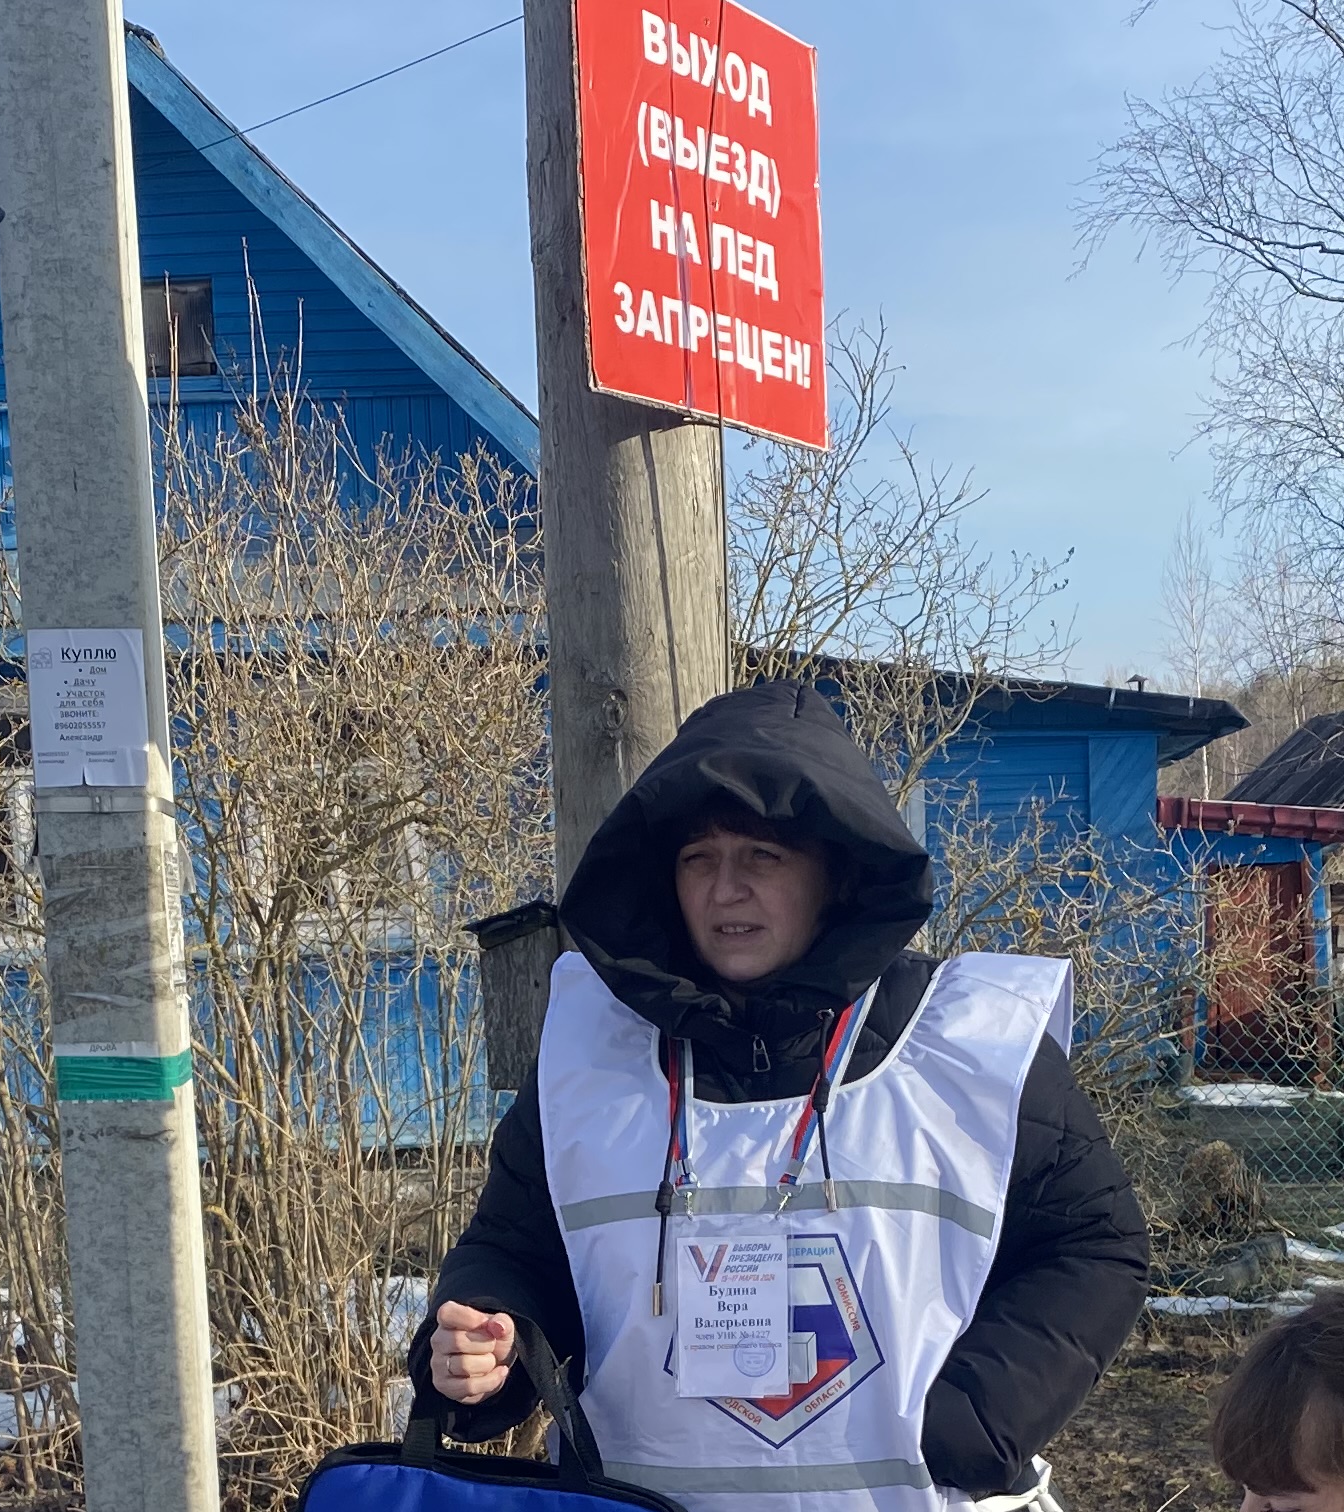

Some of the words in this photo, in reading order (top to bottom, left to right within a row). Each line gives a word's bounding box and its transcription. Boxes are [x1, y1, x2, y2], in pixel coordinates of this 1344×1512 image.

[641, 9, 773, 127] ВЫХОД
[636, 101, 782, 220] (ВЫЕЗД)
[650, 199, 703, 267] НА
[710, 221, 780, 302] ЛЕД
[613, 281, 812, 389] ЗАПРЕЩЕН!
[60, 647, 117, 663] Куплю
[732, 1243, 771, 1252] ВЫБОРЫ
[788, 1246, 835, 1257] ДЕРАЦИЯ
[727, 1253, 783, 1263] ПРЕЗИДЕНТА
[723, 1264, 759, 1273] РОССИИ
[708, 1284, 757, 1298] Будина
[716, 1301, 748, 1313] Вера
[834, 1276, 861, 1332] КОМИССИЯ
[694, 1316, 772, 1330] Валерьевна
[804, 1379, 847, 1414] ОБЛАСТИ
[724, 1397, 763, 1426] ОДСКОЙ
